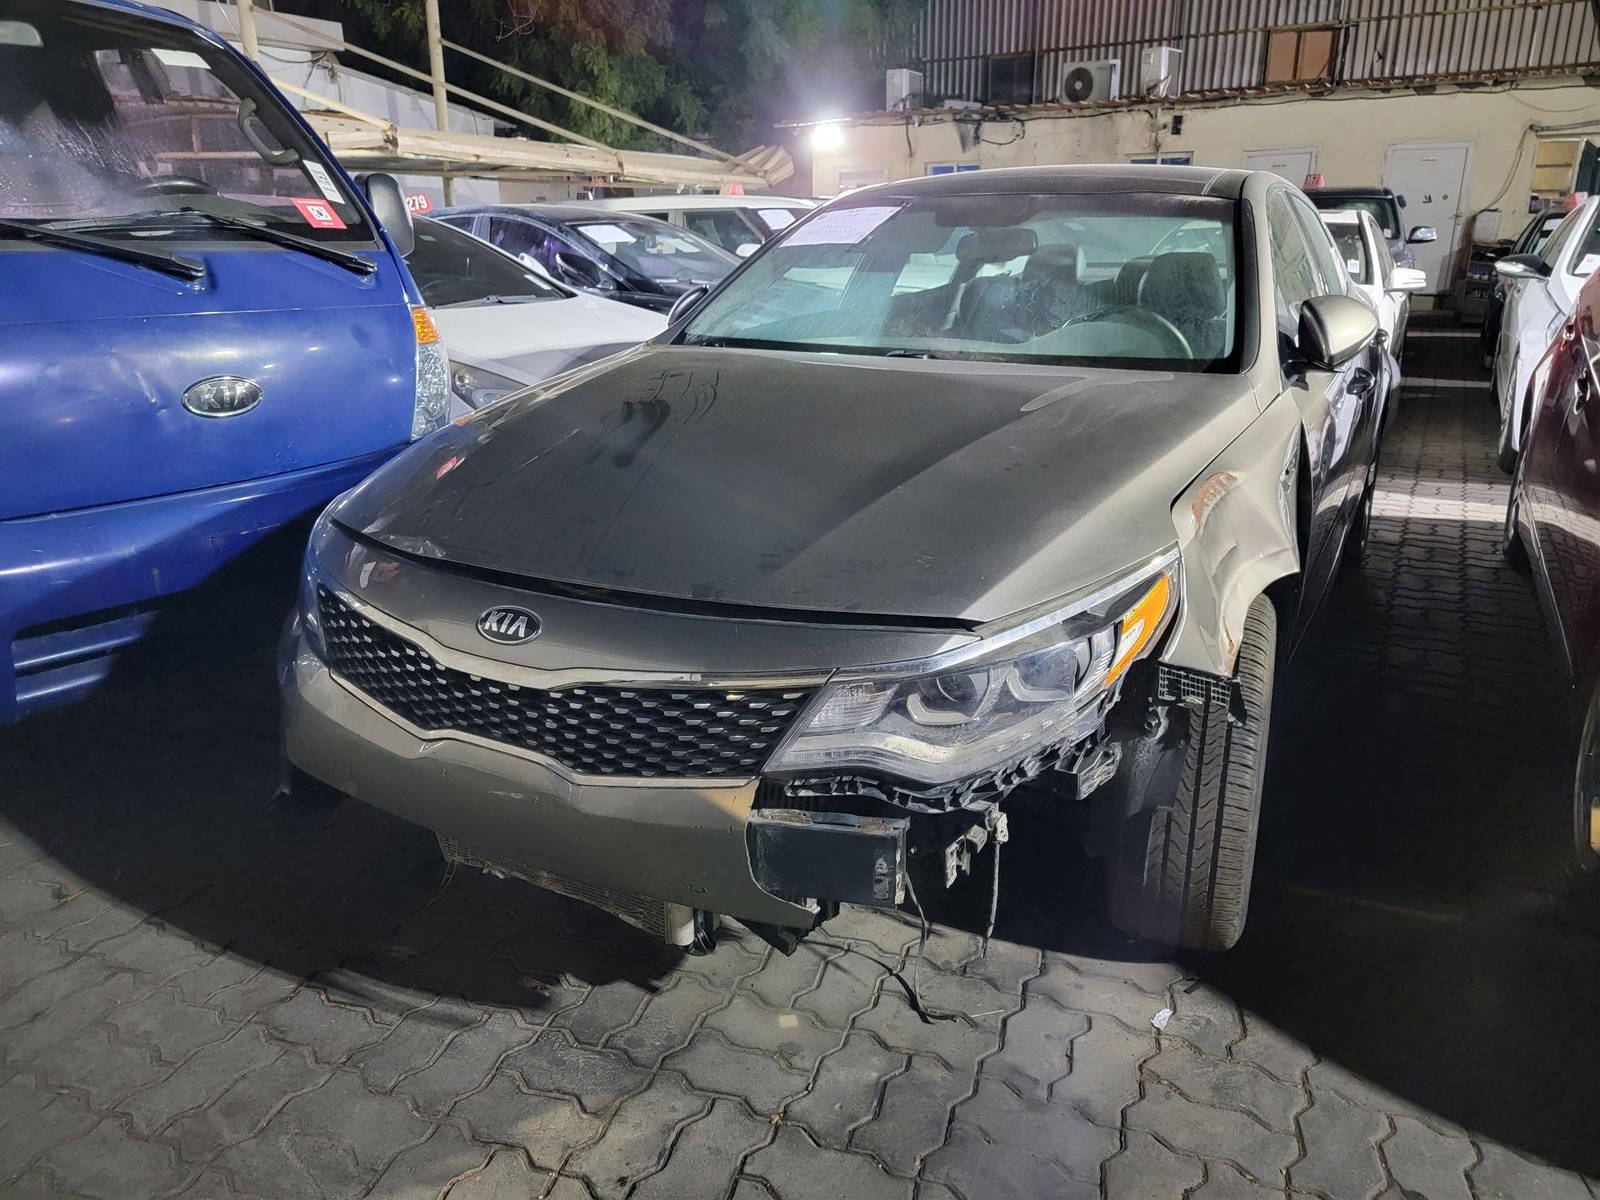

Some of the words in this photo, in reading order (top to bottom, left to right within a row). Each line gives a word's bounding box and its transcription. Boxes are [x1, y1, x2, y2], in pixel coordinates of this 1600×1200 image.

[406, 194, 428, 212] 279
[200, 383, 251, 410] KIA
[484, 610, 528, 638] KIA
